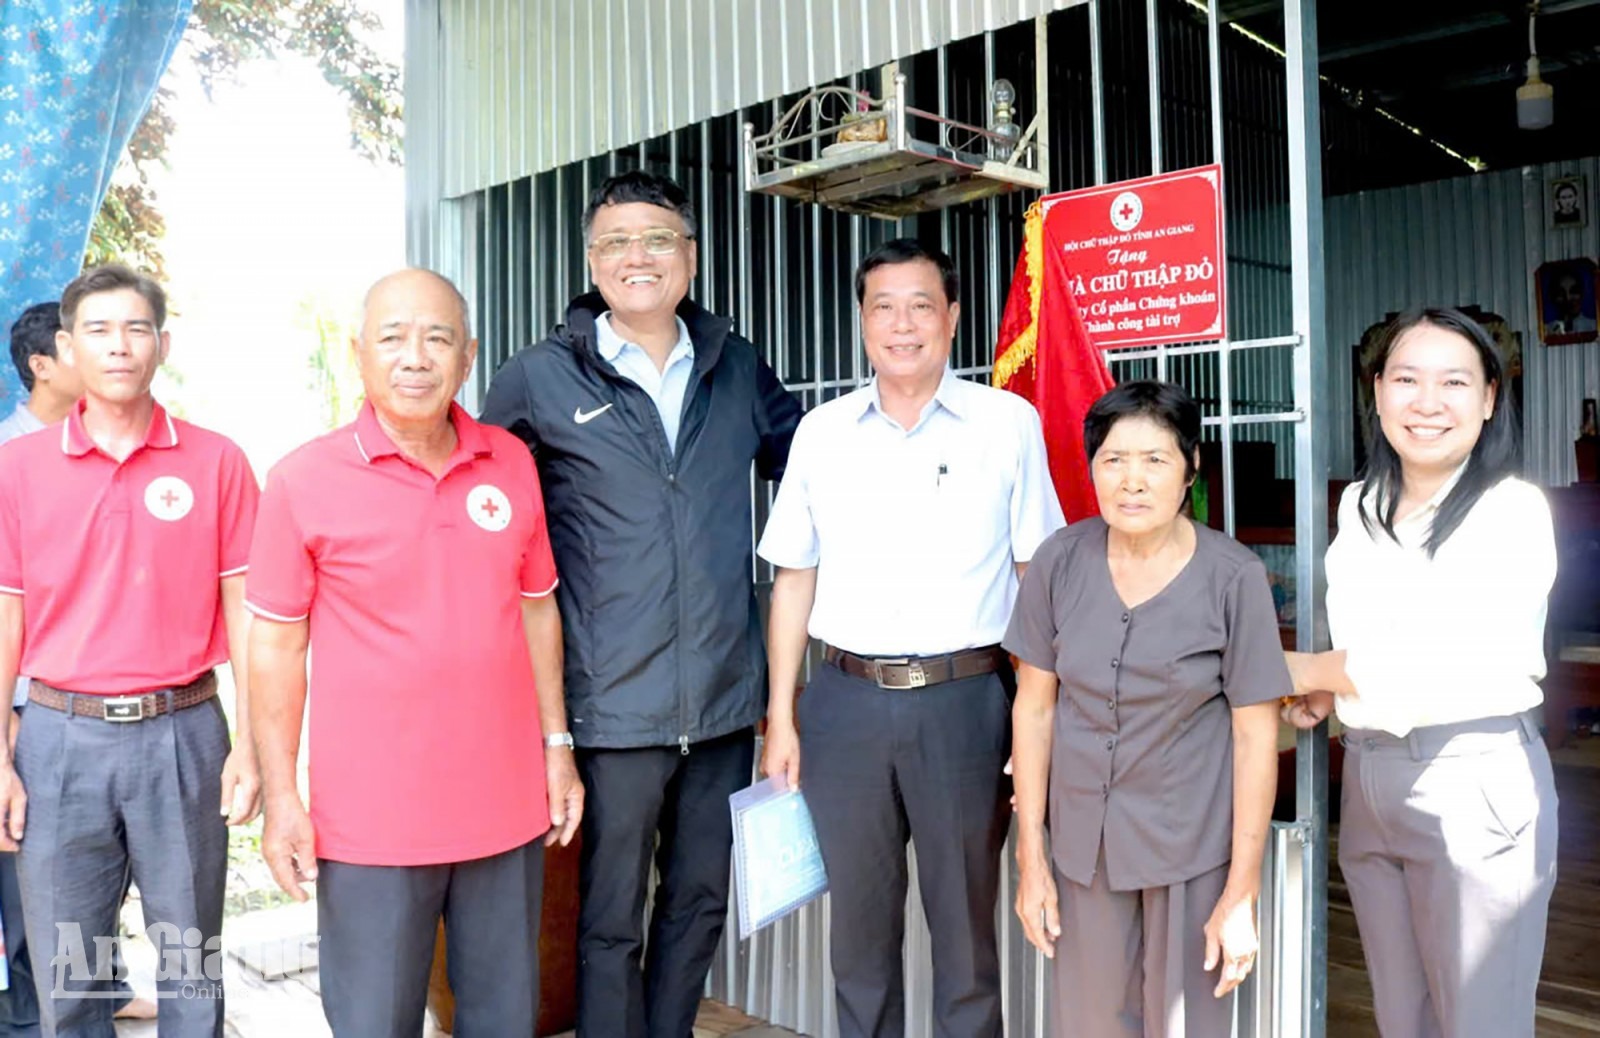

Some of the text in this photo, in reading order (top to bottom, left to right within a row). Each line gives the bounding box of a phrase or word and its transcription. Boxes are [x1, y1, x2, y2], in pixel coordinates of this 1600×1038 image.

[1155, 228, 1166, 238] AN
[1167, 224, 1194, 237] GIANG
[1107, 249, 1148, 265] Tặng
[1090, 270, 1129, 293] CHỮ
[1131, 263, 1182, 289] THẬP
[1185, 256, 1214, 282] ĐỎ
[1179, 289, 1216, 306] khoán
[1117, 316, 1144, 332] công
[1163, 312, 1181, 328] trợ
